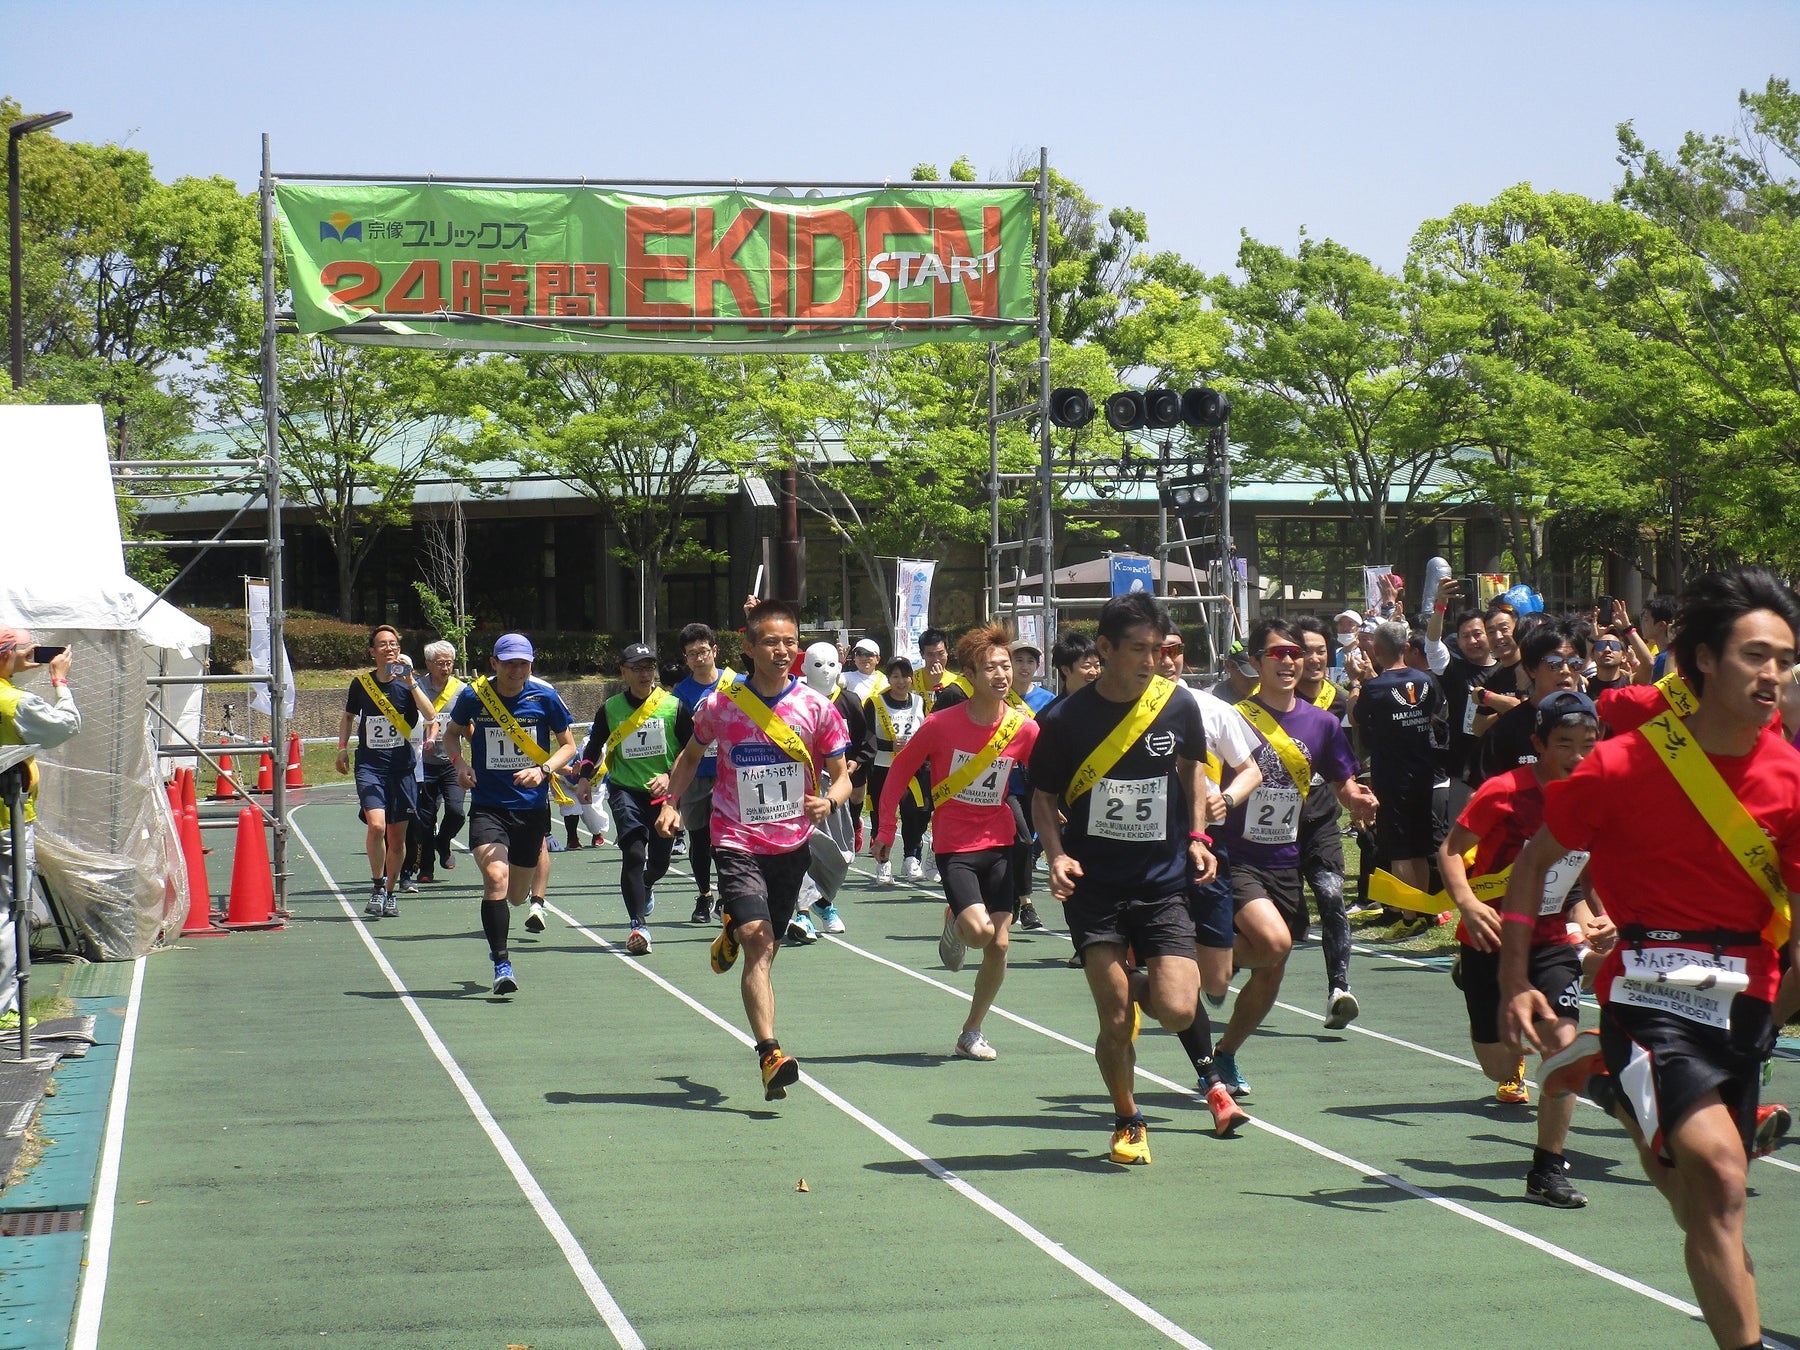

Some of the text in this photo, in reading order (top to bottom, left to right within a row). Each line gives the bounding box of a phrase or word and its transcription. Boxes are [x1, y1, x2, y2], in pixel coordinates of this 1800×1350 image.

[367, 220, 529, 250] 宗像ユリックス
[319, 206, 1002, 333] 24時間 EKIDEN
[866, 244, 1003, 309] START
[373, 725, 398, 738] 28
[637, 731, 648, 745] 7
[892, 723, 912, 735] 32
[735, 753, 776, 763] Running
[754, 780, 788, 805] 11
[1099, 779, 1161, 795] がんばろう日本!
[1105, 797, 1153, 822] 25
[1258, 804, 1295, 826] 24
[1671, 1001, 1712, 1021] EKIDEN
